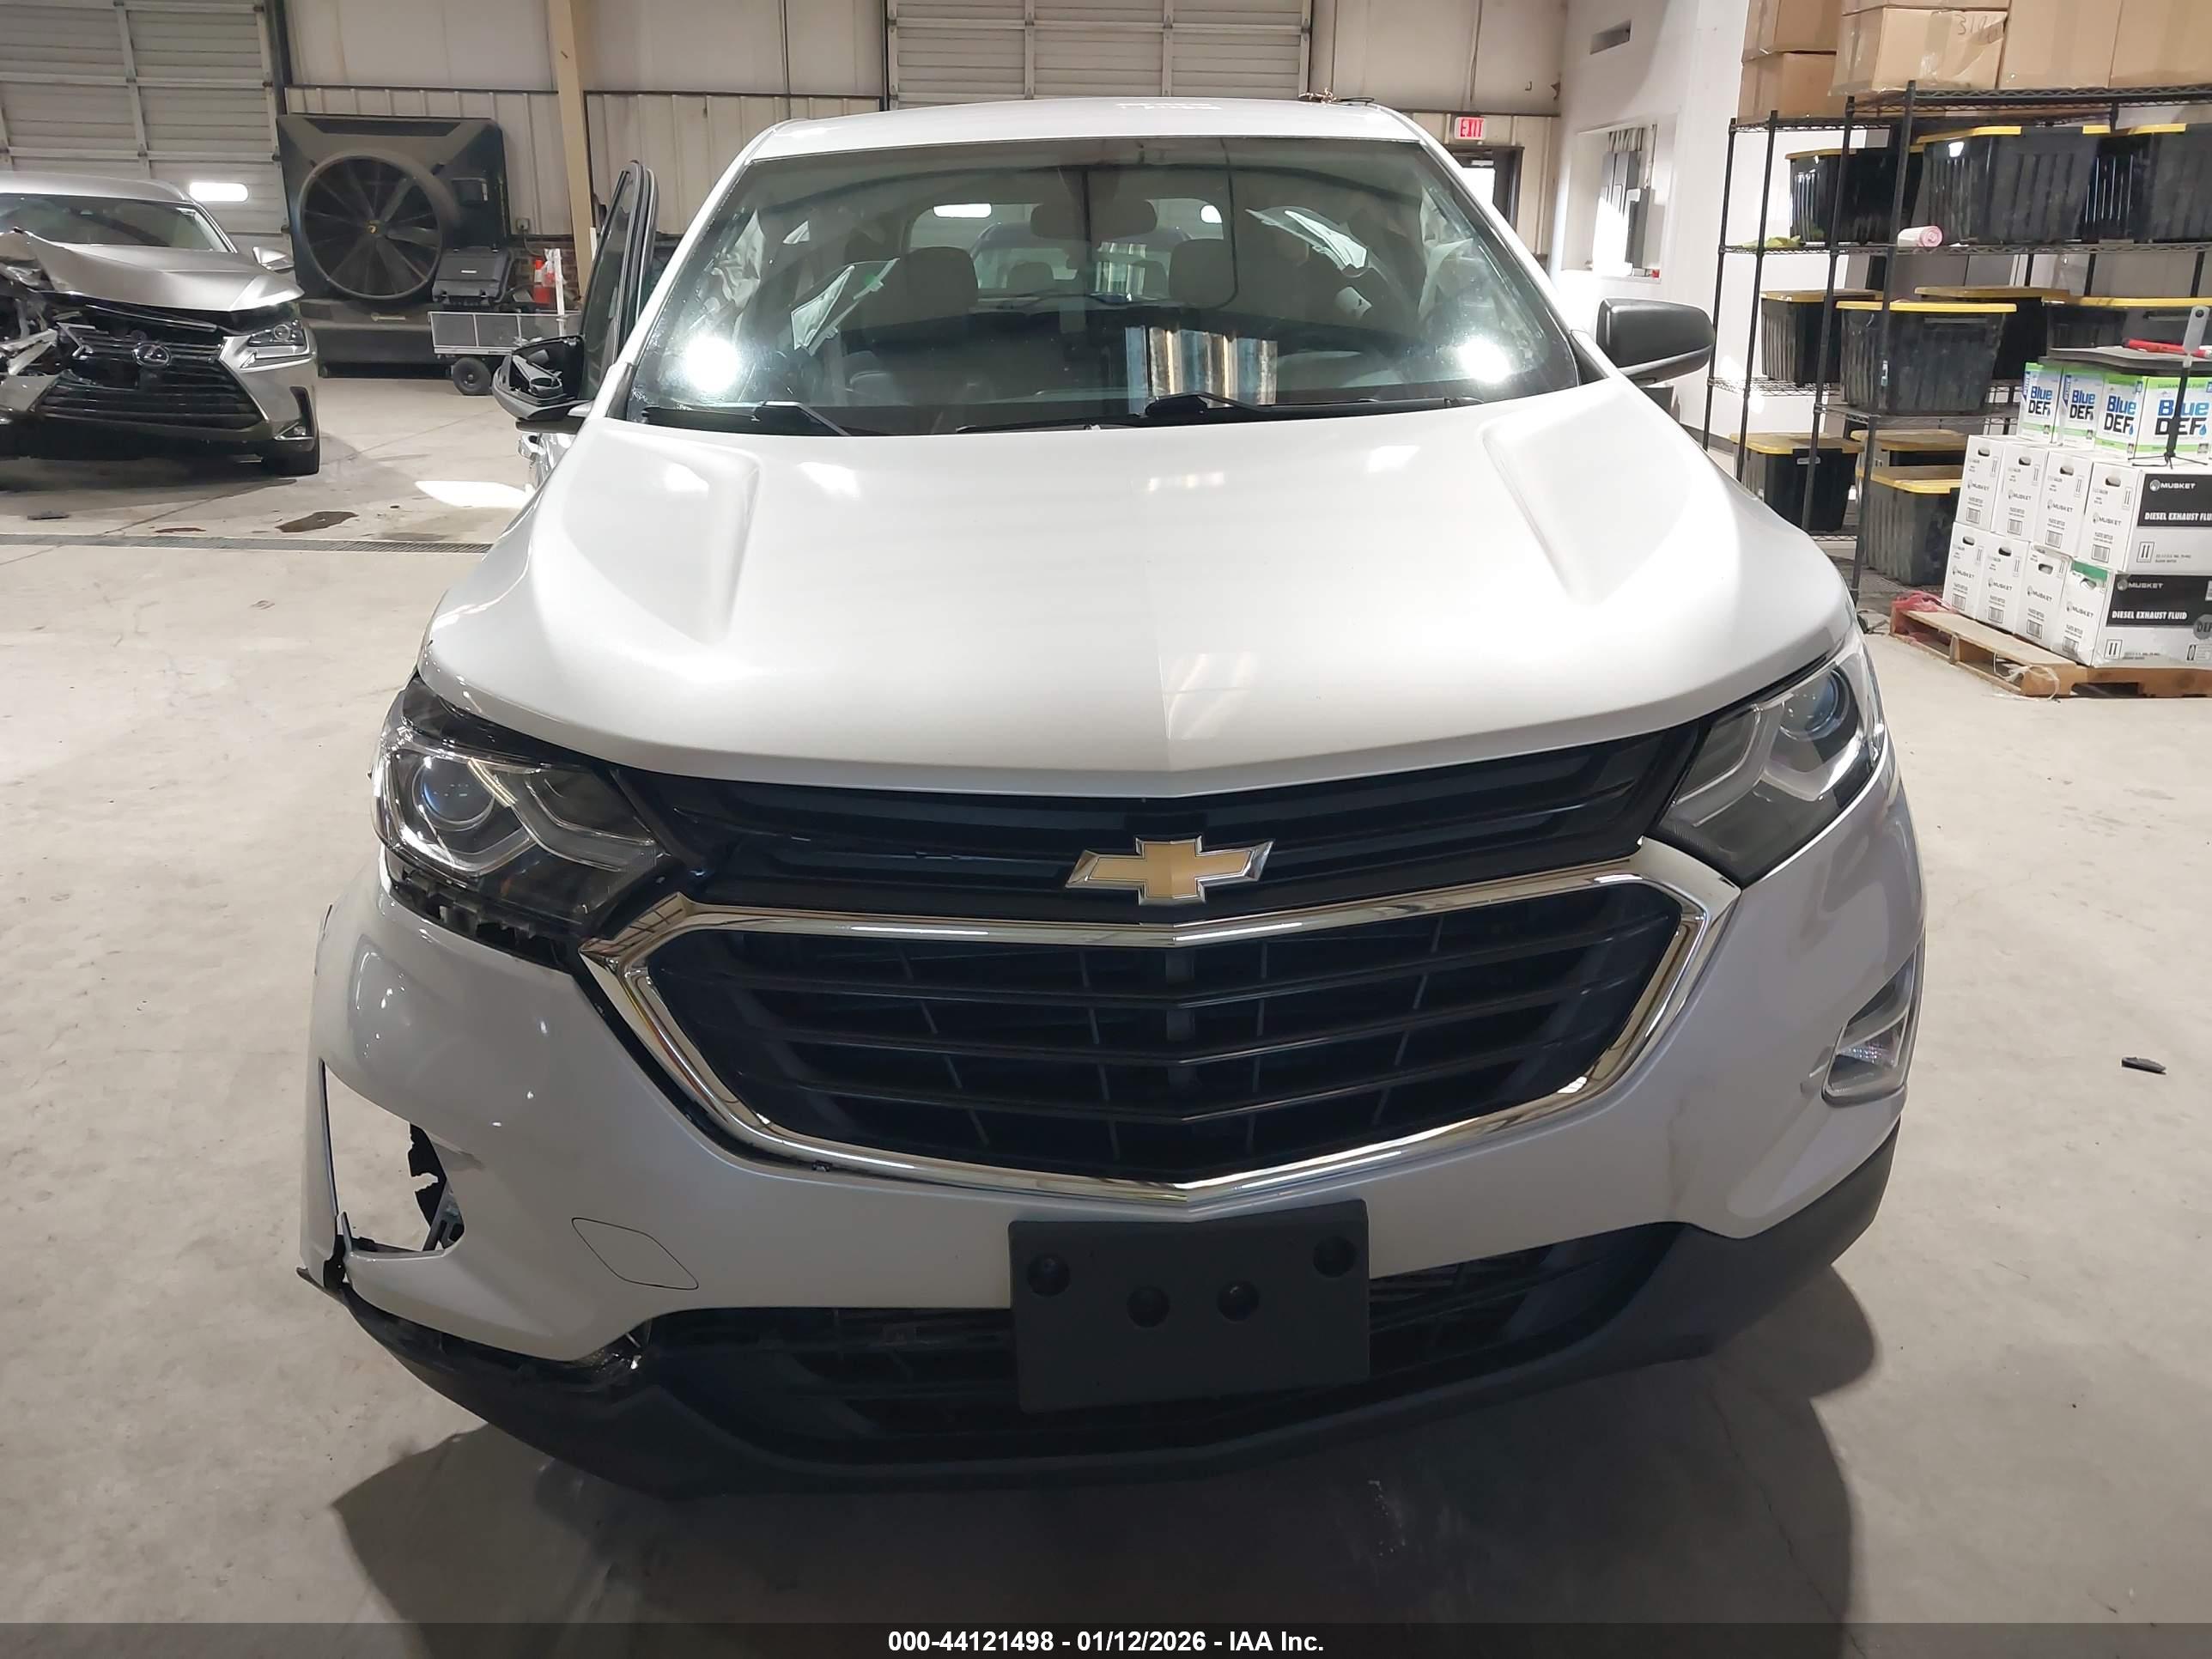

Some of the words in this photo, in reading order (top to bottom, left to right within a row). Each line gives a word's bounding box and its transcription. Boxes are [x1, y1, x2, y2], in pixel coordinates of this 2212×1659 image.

[1460, 118, 1484, 137] EXIT
[2030, 386, 2053, 400] Blue
[2071, 389, 2095, 404] Blue
[2027, 399, 2051, 416] DEF
[2069, 404, 2094, 420] DEF
[2106, 395, 2136, 416] Blue
[2157, 399, 2210, 416] Bue
[2104, 412, 2135, 433] DEF
[2144, 512, 2167, 520] DIESEL
[2168, 512, 2199, 520] EXHAUST
[2112, 611, 2135, 619] DIESEL
[2136, 611, 2167, 619] EXHAUST
[2167, 611, 2188, 620] FLUID
